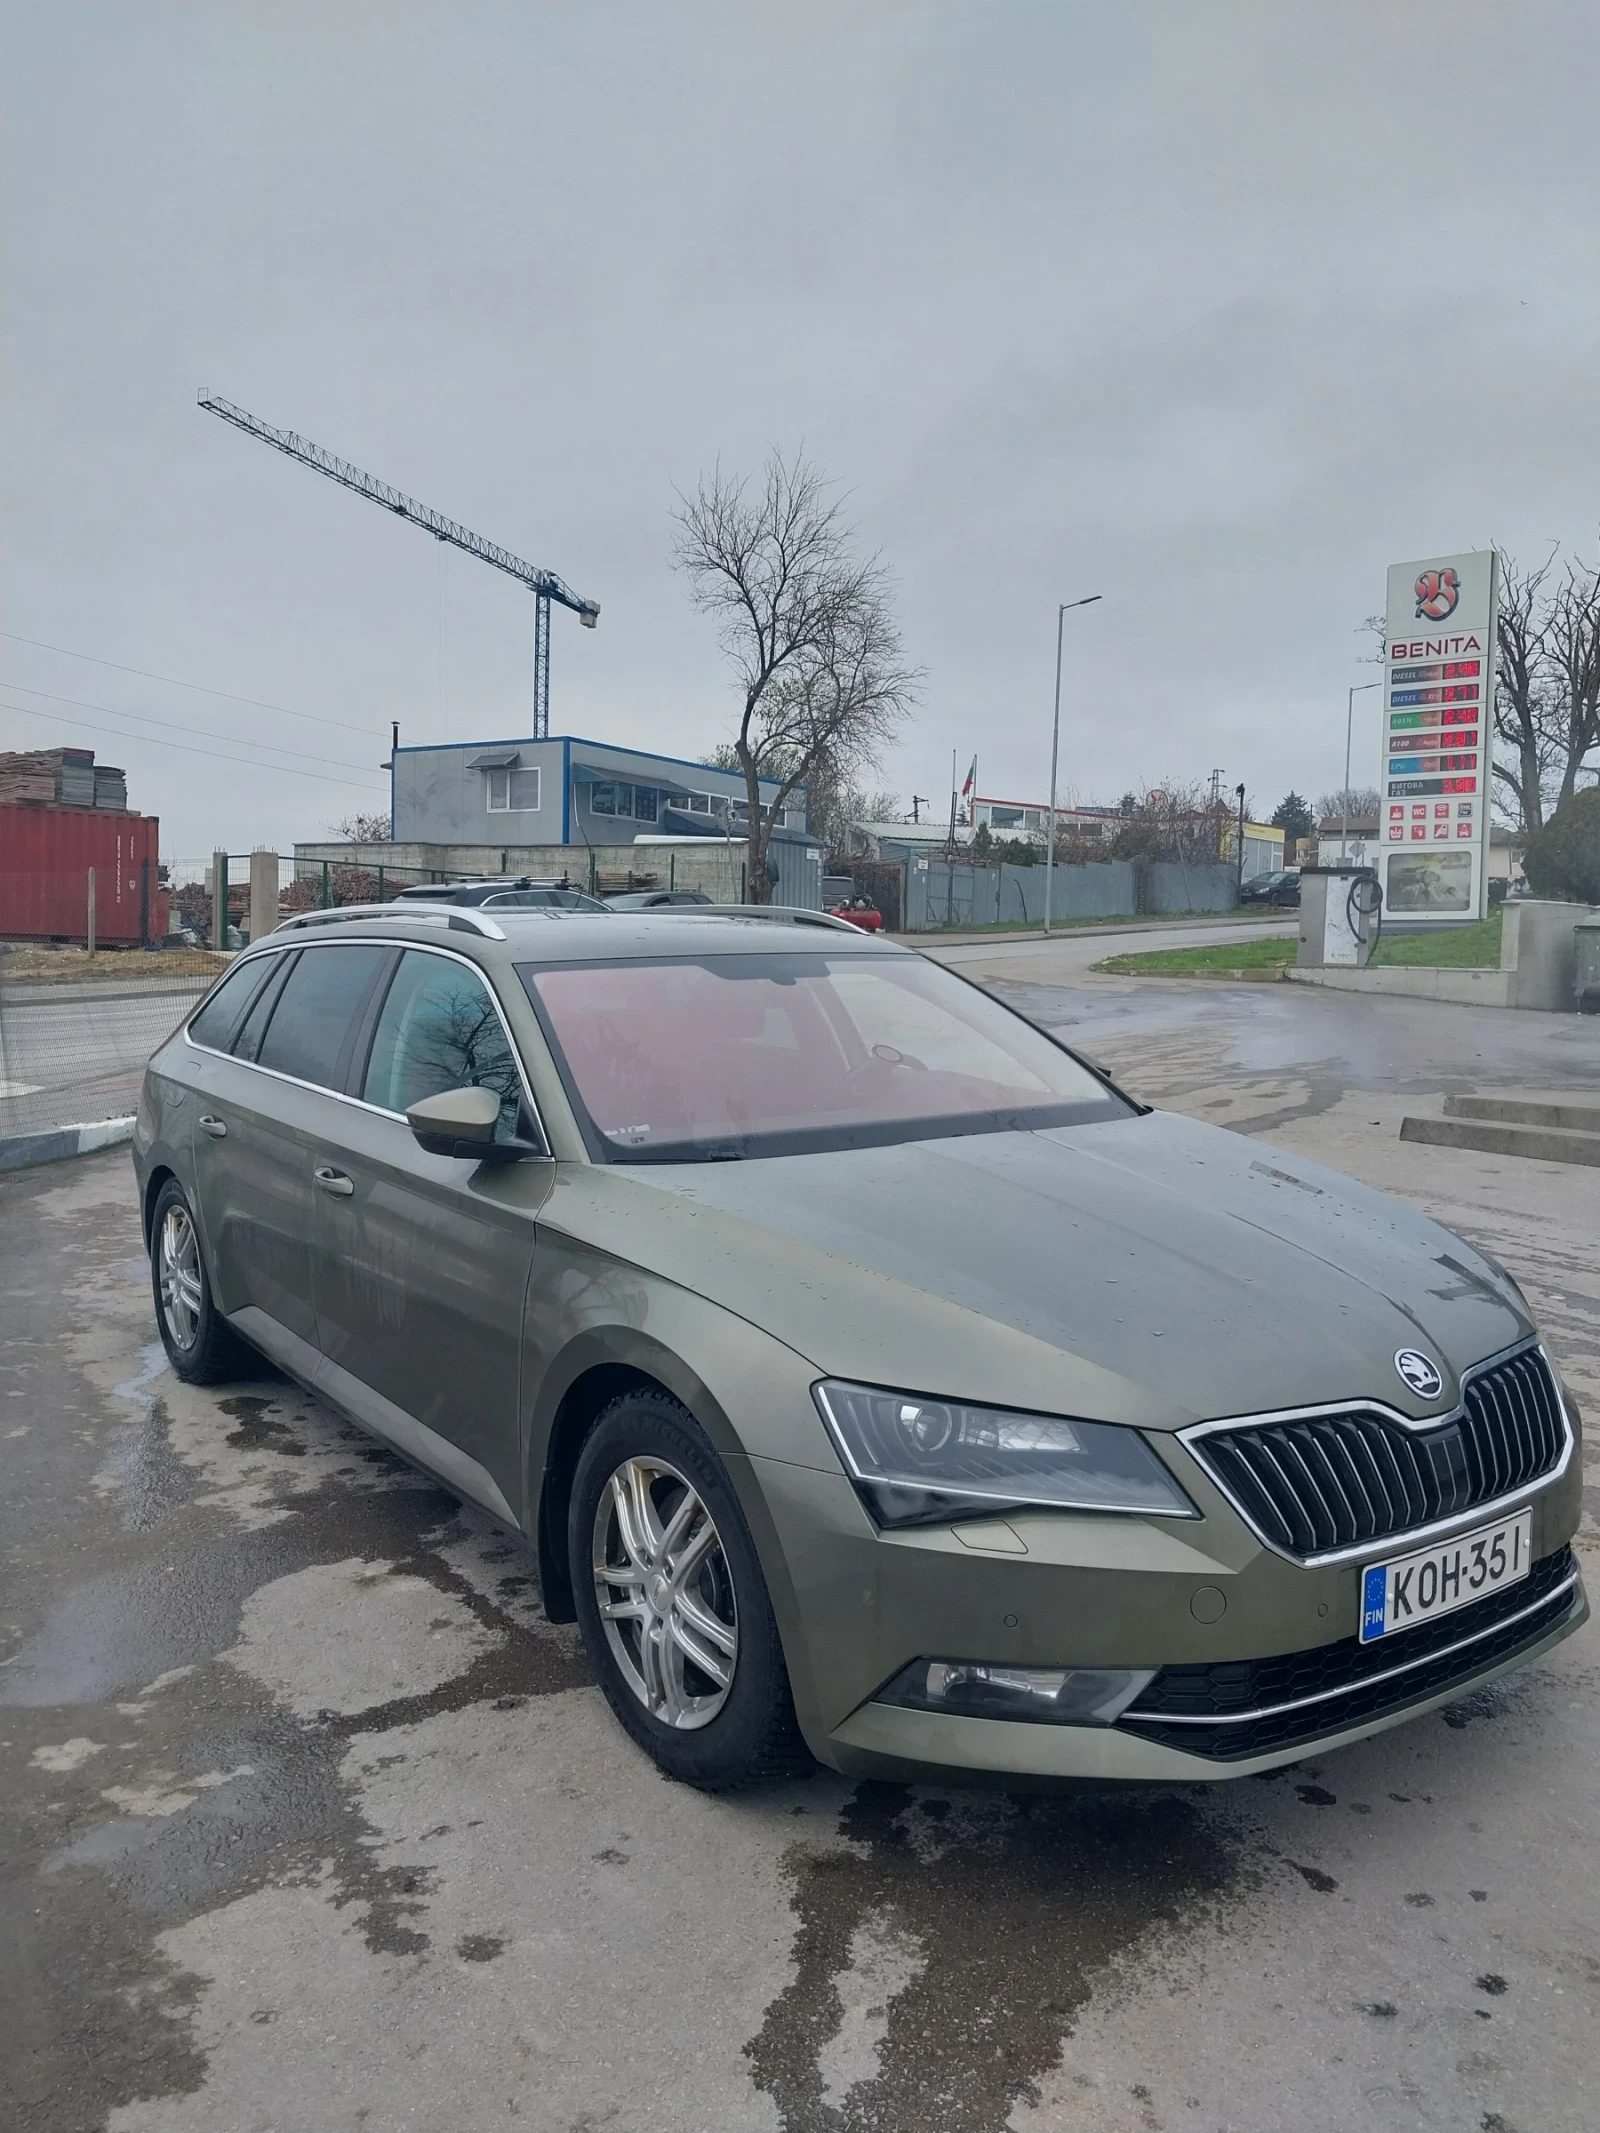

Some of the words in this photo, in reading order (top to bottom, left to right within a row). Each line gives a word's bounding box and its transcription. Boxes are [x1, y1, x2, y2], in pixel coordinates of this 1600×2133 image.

[1391, 635, 1481, 659] BENITA
[1392, 671, 1416, 680] DIESEL
[1392, 695, 1416, 703] DIESEL
[1444, 685, 1478, 702] 2.71
[1444, 707, 1478, 725] 2.42
[1391, 740, 1410, 748] A100
[1391, 781, 1424, 790] БИТОВА
[1391, 789, 1406, 797] ГАЗ
[1413, 807, 1425, 816] WC
[1393, 1525, 1520, 1620] KOH-351
[1364, 1607, 1384, 1627] FIN
